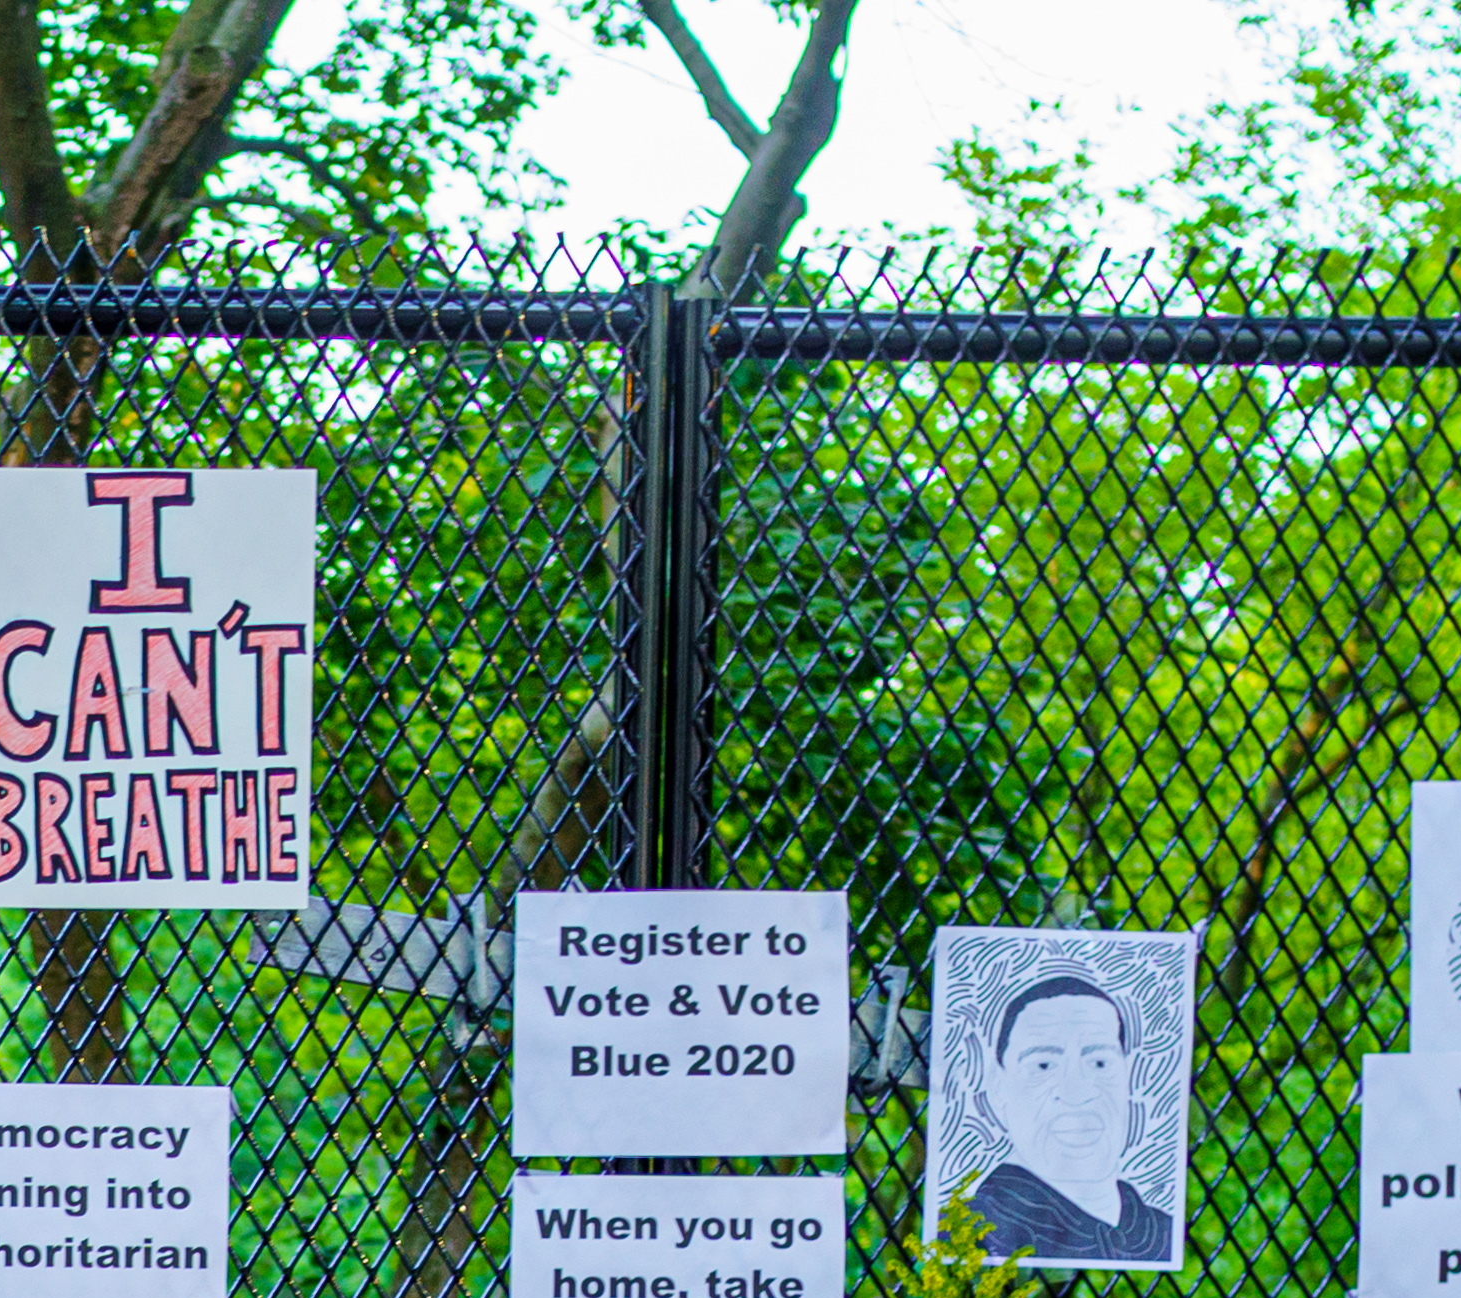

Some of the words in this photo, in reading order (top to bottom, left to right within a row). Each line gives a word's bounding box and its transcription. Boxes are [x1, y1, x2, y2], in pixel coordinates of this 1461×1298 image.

[87, 471, 192, 612] I
[557, 924, 750, 964] Register
[764, 926, 806, 957] to
[546, 986, 650, 1019] Vote
[668, 986, 699, 1019] &
[718, 986, 819, 1019] Vote
[570, 1044, 669, 1079] Blue
[688, 1044, 796, 1079] 2020
[106, 1175, 191, 1210] into
[537, 1209, 657, 1239] When
[675, 1218, 753, 1248] you
[771, 1218, 822, 1248] go
